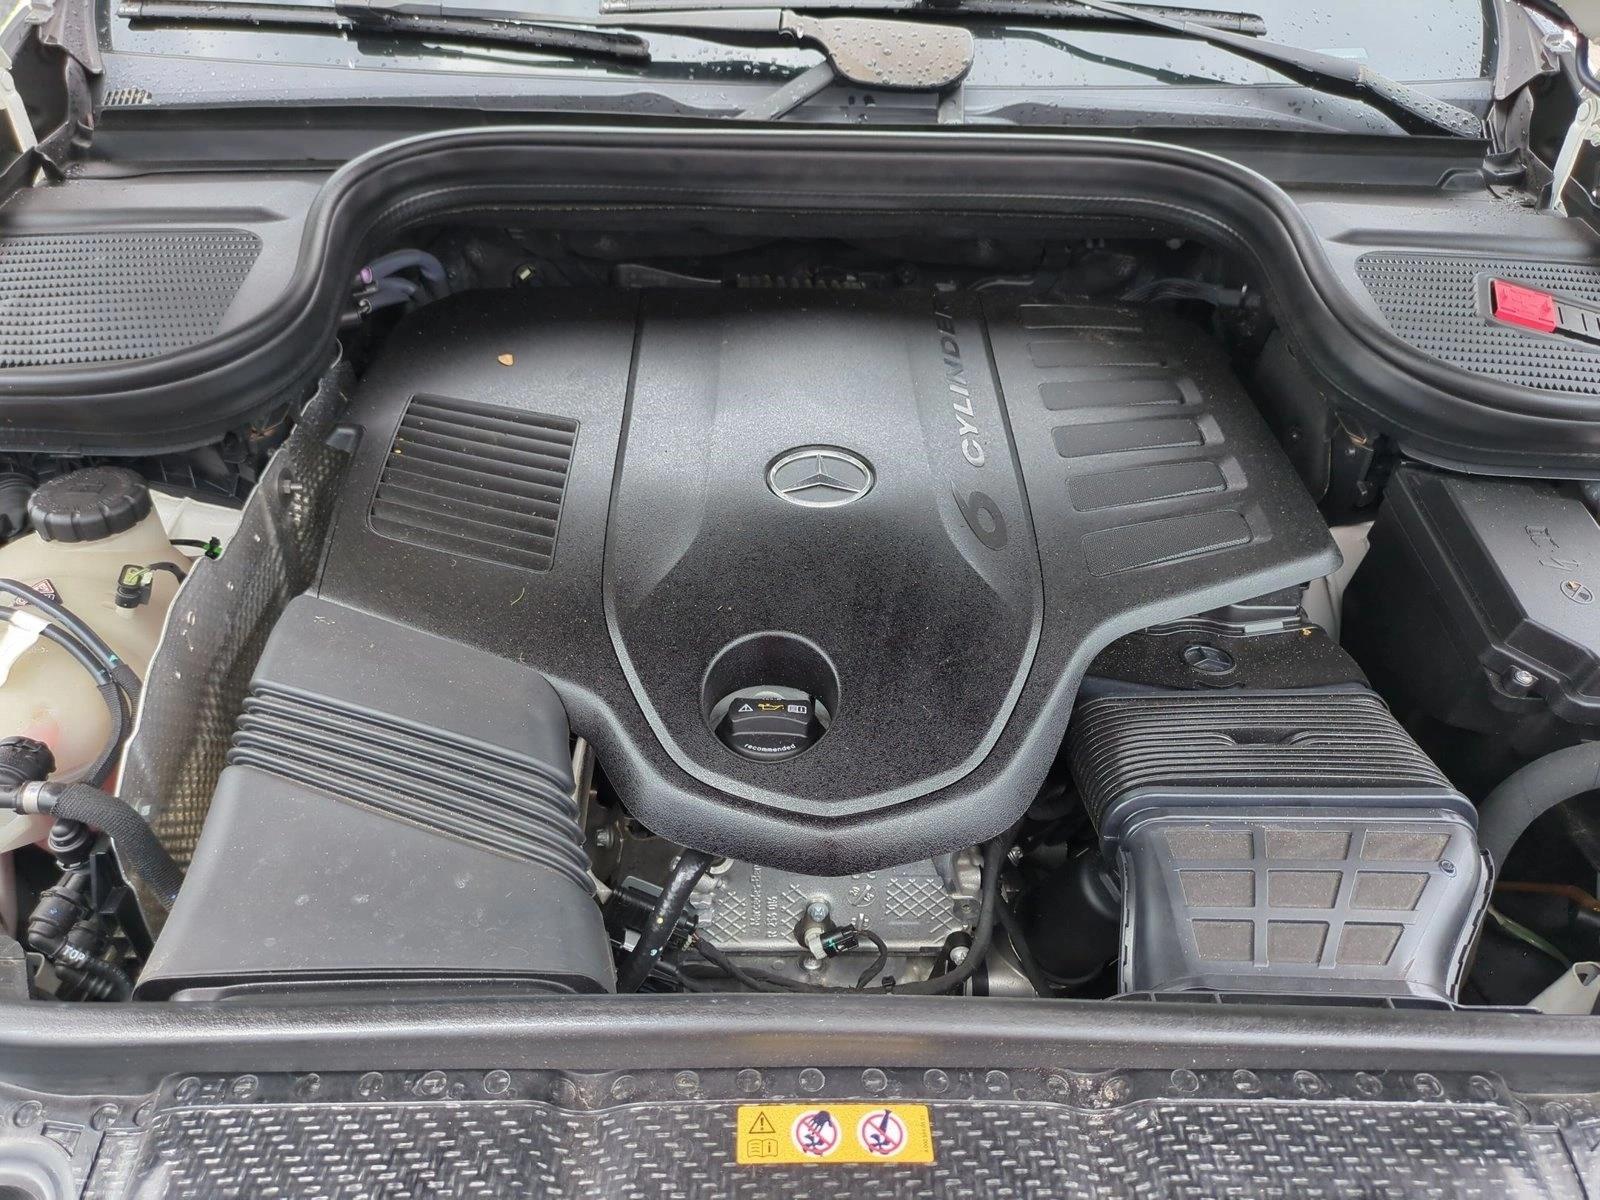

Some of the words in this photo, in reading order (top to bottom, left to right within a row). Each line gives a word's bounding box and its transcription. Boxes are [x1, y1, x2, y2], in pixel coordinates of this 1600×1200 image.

[950, 480, 1007, 550] 6
[744, 742, 796, 752] recommended
[750, 864, 761, 926] Mercedes-Ben
[62, 944, 86, 962] TOP
